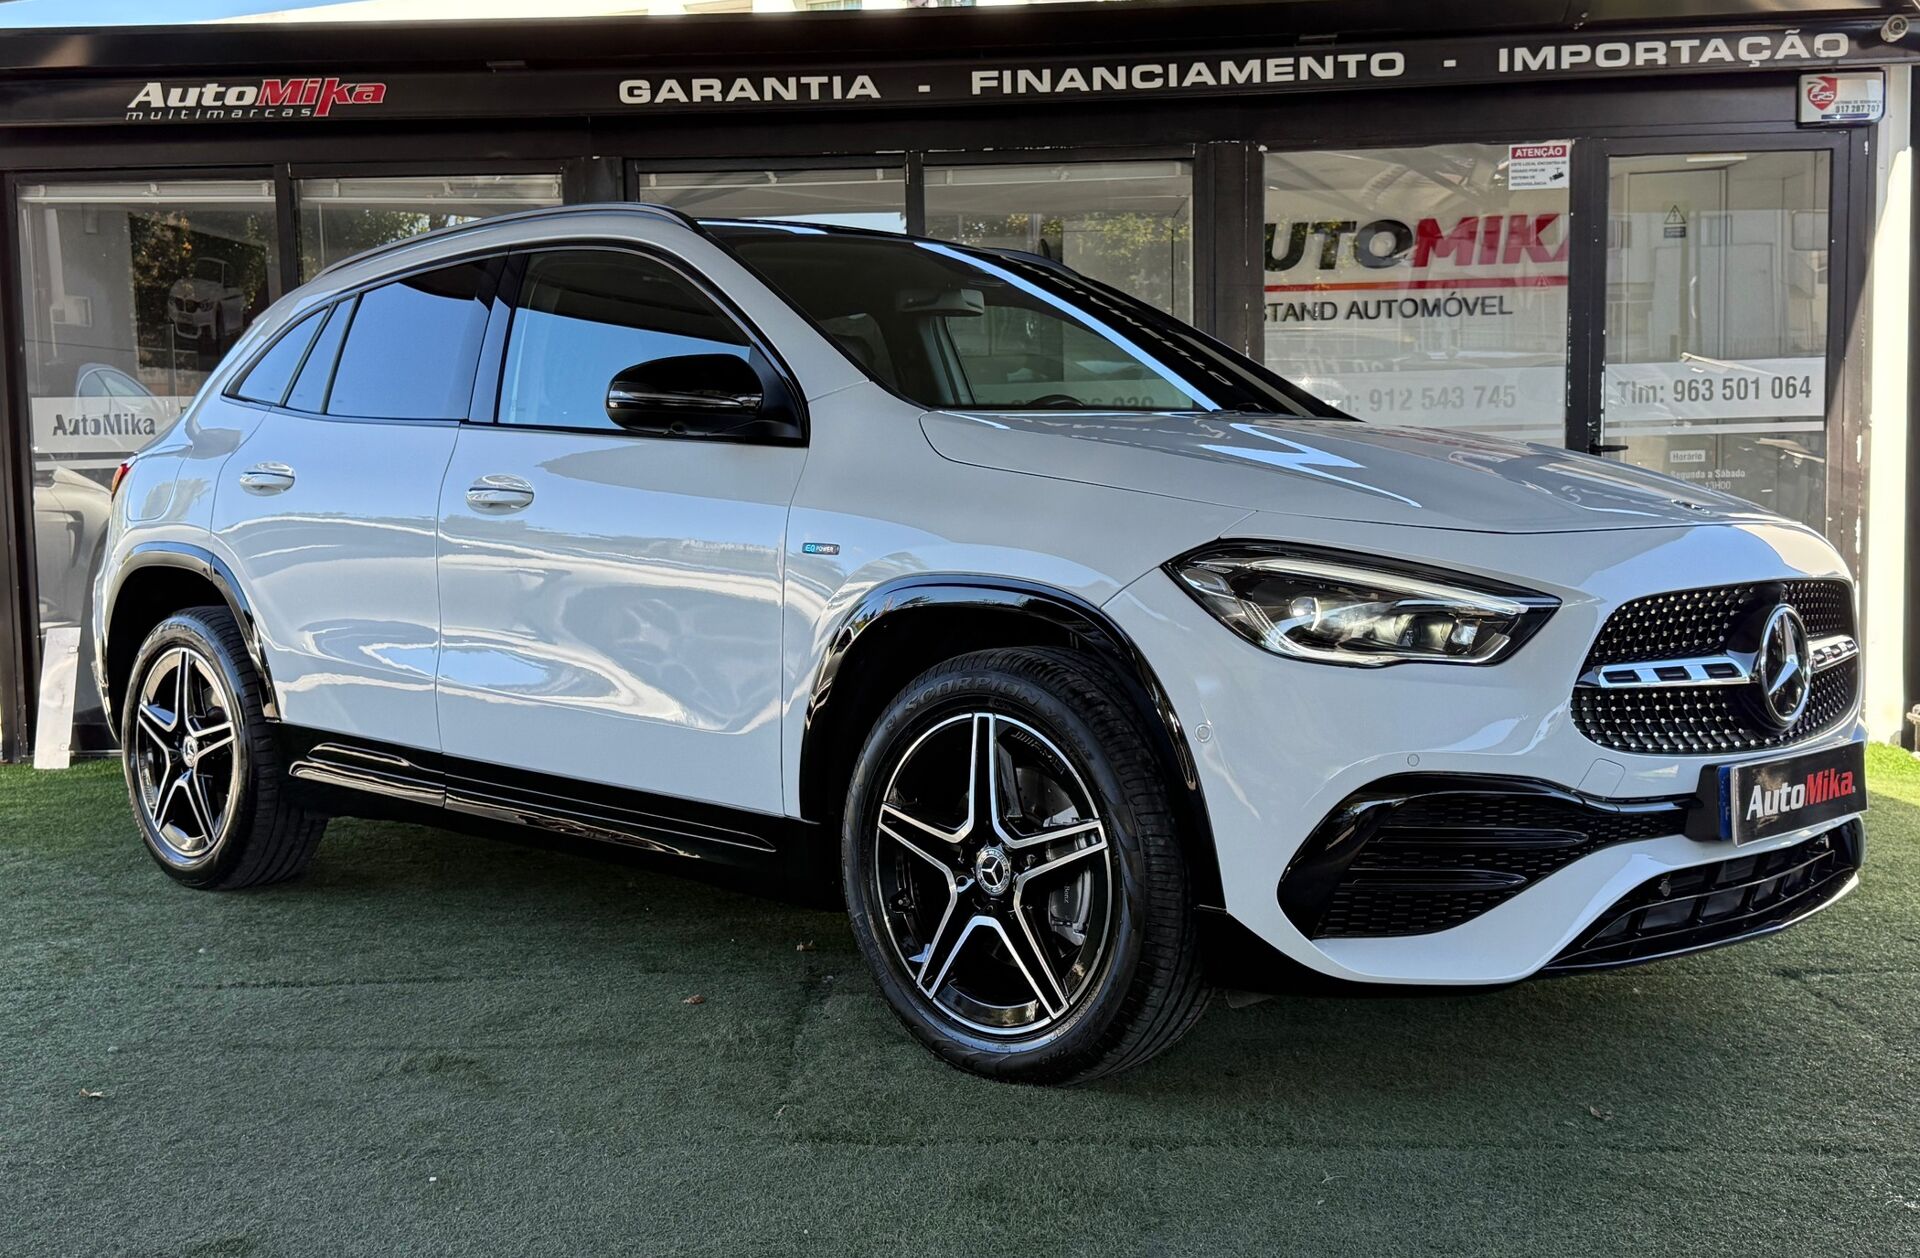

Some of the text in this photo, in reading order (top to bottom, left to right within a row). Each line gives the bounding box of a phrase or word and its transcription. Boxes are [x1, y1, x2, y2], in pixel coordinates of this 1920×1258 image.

[618, 75, 881, 104] GARANTIA
[971, 52, 1405, 95] FINANCIAMENTO
[1498, 29, 1849, 72] IMPORTAÇÃO
[127, 77, 387, 117] AutoMika
[125, 108, 312, 121] multimarcas
[1514, 146, 1563, 158] ATENÇÃO
[1264, 213, 1568, 272] UTOMIK
[1345, 292, 1513, 320] AUTOMÓVEL
[1369, 388, 1412, 412] 912
[1421, 387, 1464, 409] 543
[1473, 385, 1516, 408] 745
[1673, 379, 1714, 402] 963
[1722, 377, 1760, 400] 501
[1771, 375, 1812, 399] 064
[53, 413, 156, 436] AutoMika
[1672, 453, 1703, 461] Horário
[1715, 468, 1746, 478] Sábado
[1746, 768, 1854, 821] AutoMika
